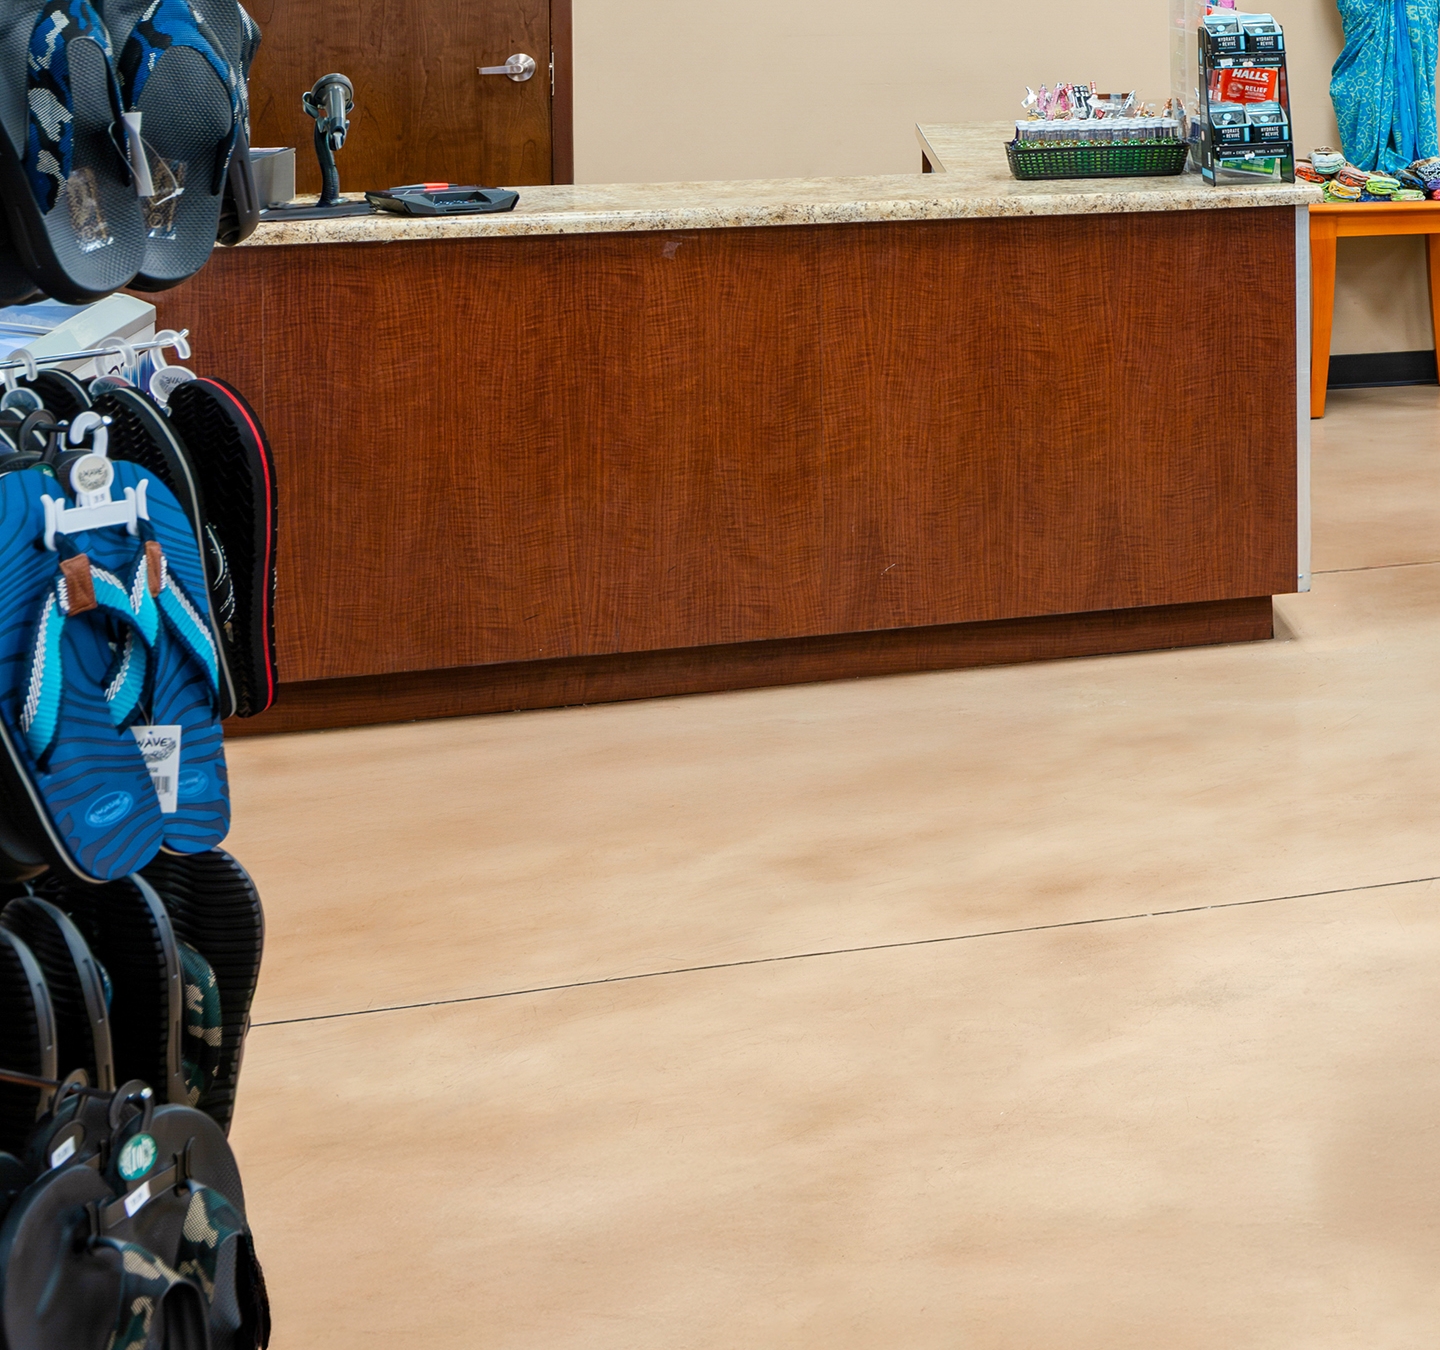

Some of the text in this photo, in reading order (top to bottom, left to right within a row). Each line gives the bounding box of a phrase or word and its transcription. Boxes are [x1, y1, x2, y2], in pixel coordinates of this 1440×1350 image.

[1232, 69, 1269, 81] HALLS
[1245, 85, 1268, 93] RELIEF
[137, 737, 169, 748] WAVE
